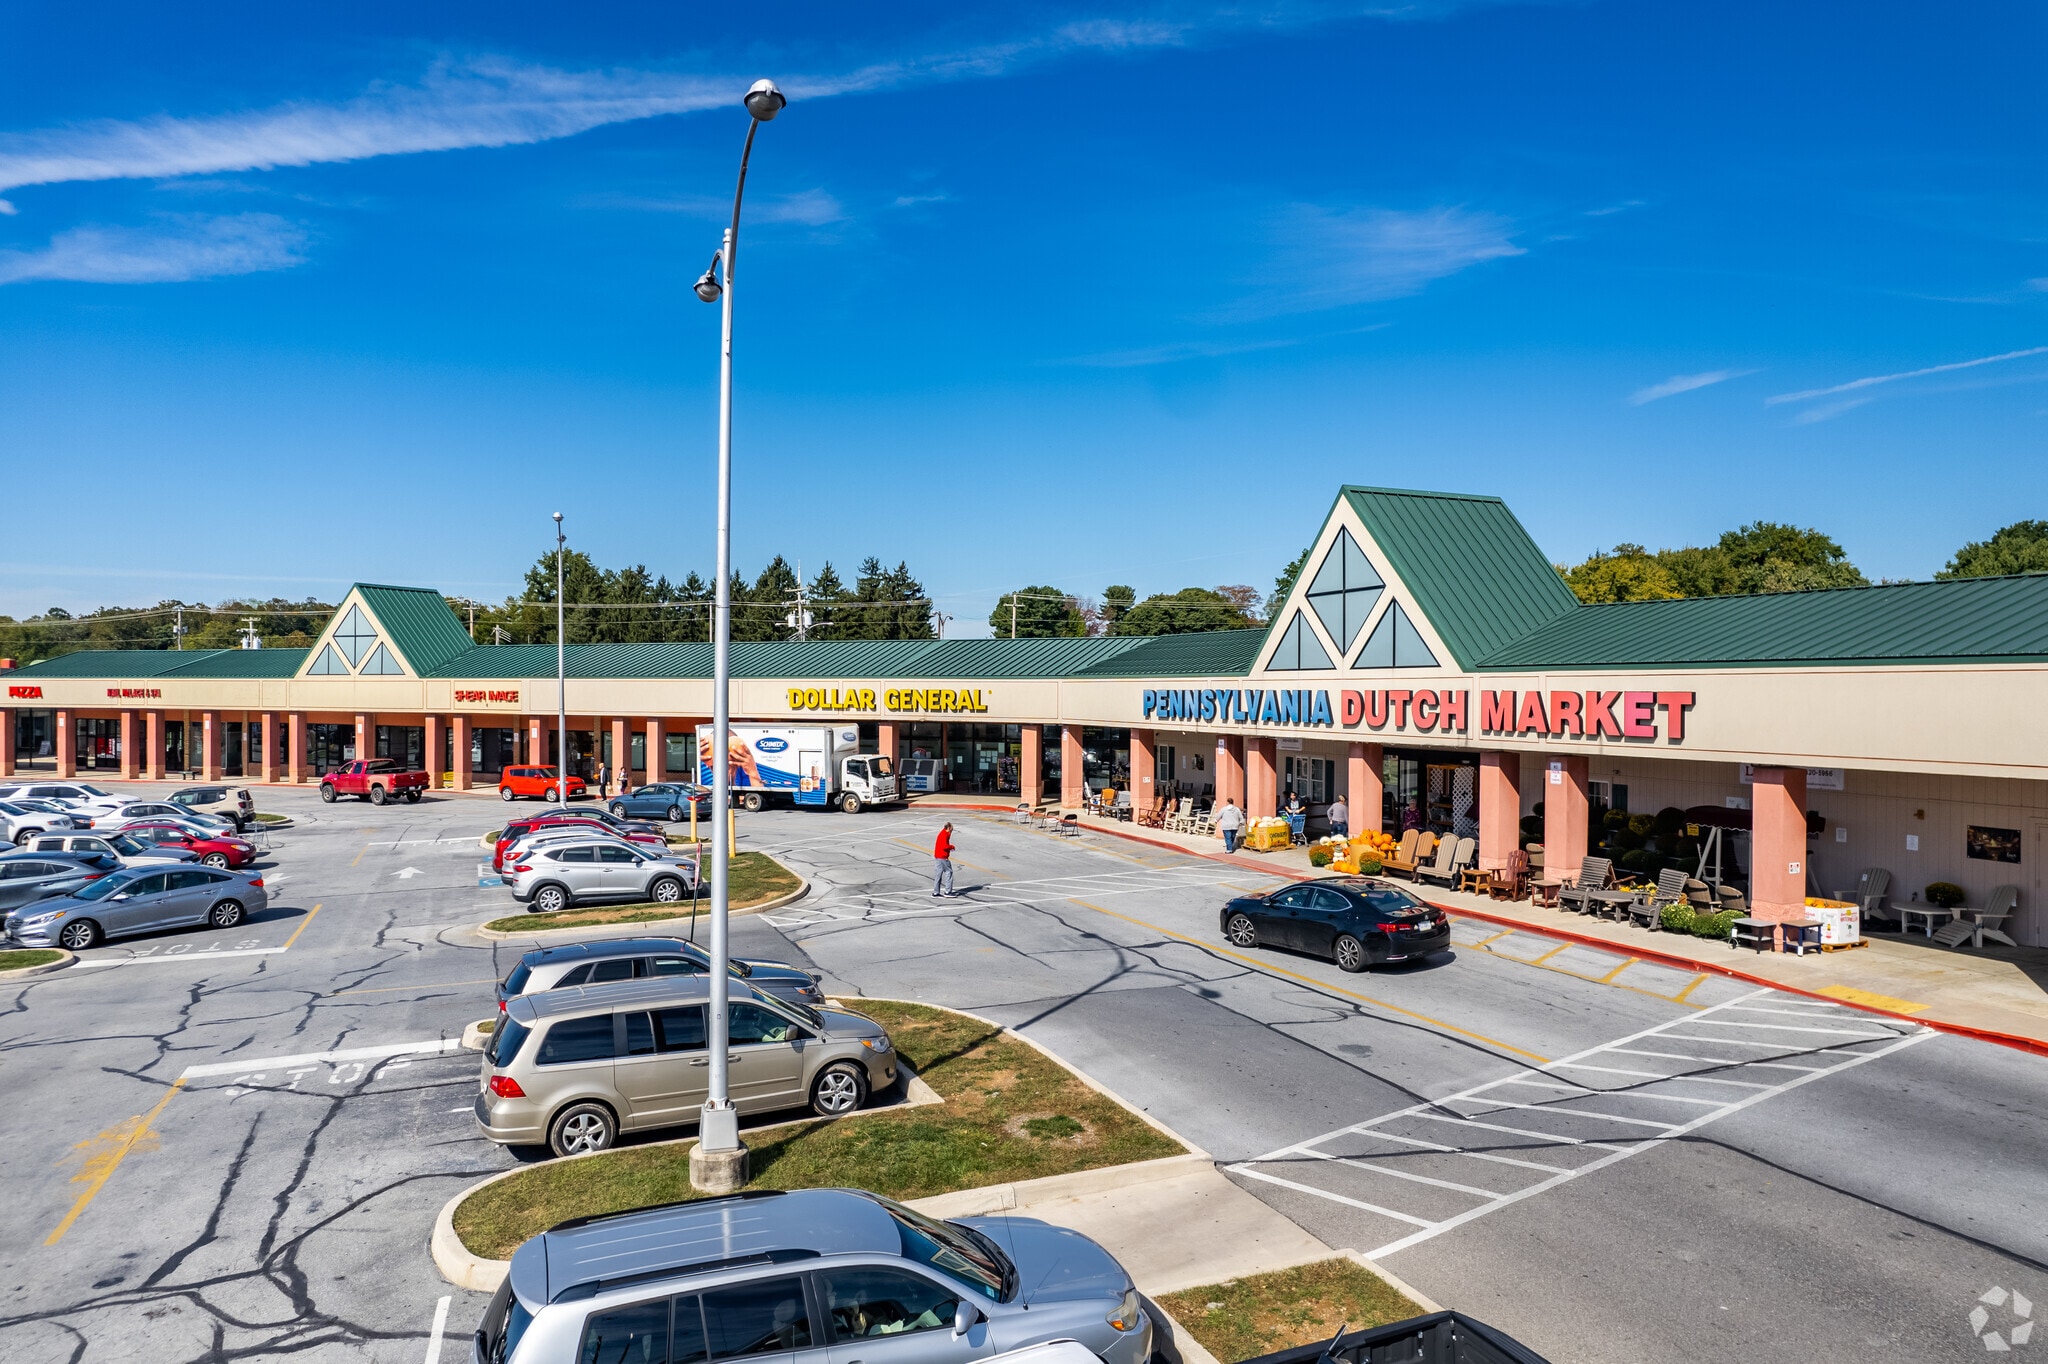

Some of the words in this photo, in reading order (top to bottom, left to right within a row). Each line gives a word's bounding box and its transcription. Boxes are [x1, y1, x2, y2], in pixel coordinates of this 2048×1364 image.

[455, 690, 486, 702] SHEAR
[488, 690, 519, 703] IMAGE
[787, 688, 876, 711] DOLLAR
[884, 688, 988, 713] GENERAL
[1143, 689, 1333, 725] PENNSYLVANIA
[1341, 689, 1468, 731] DUTCH
[1481, 690, 1695, 744] MARKET
[225, 1058, 412, 1096] STOP
